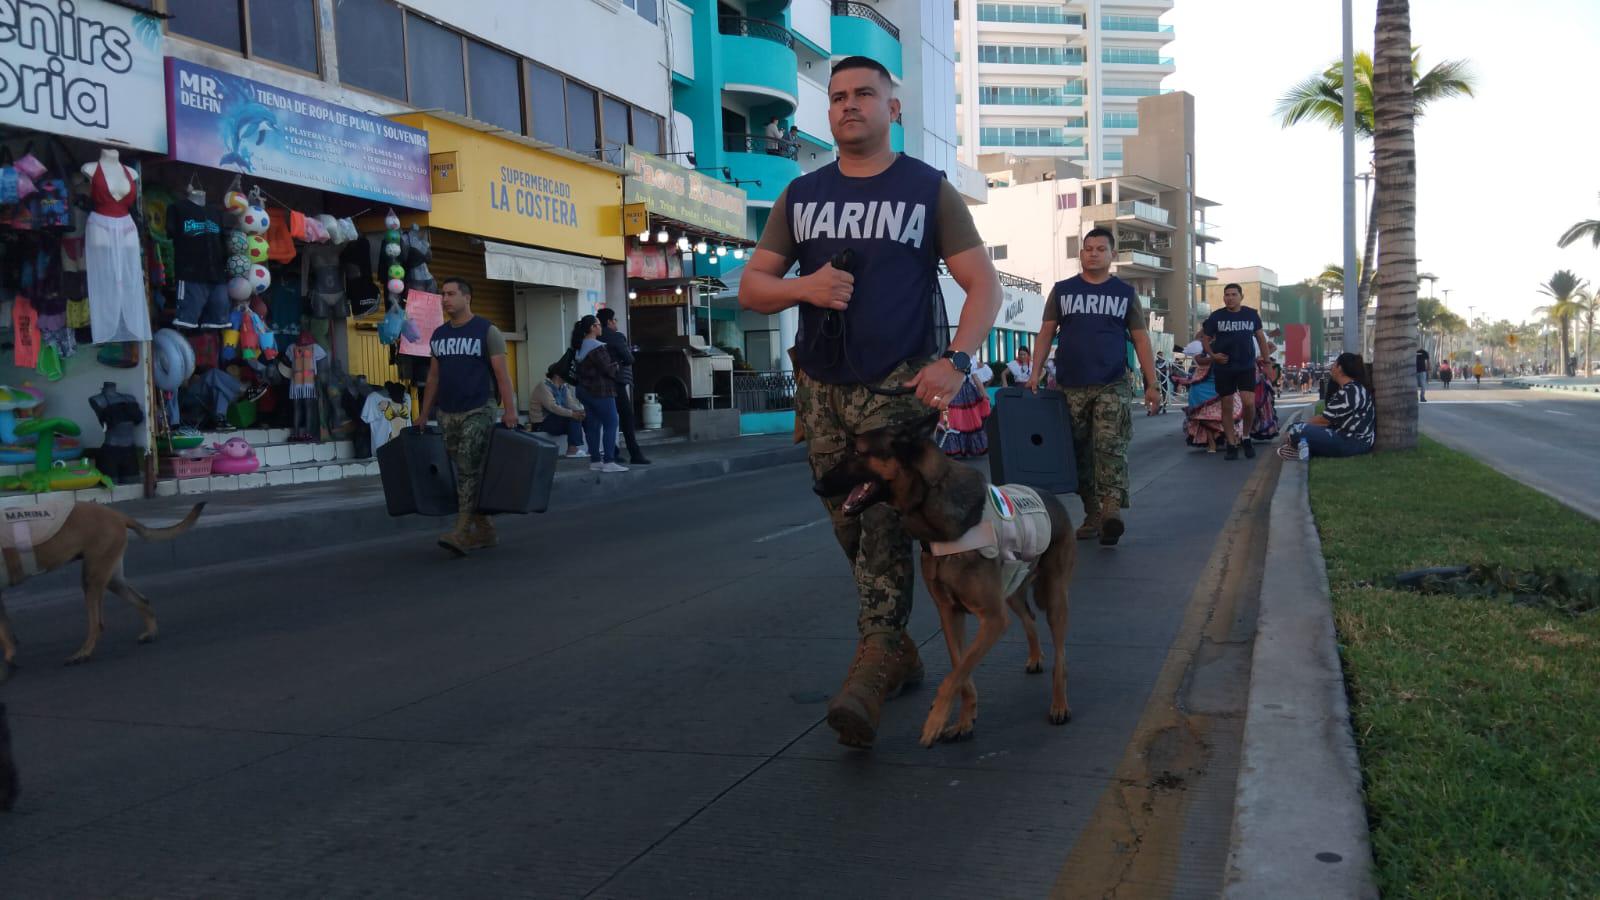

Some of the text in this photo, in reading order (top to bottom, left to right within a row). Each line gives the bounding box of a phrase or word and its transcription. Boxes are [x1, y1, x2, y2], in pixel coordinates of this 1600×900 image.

[180, 70, 223, 99] MR.
[181, 91, 221, 114] DELFIN
[257, 89, 427, 147] TIENDA DE ROPA DE PLAYA Y SOUVENIRS
[501, 166, 571, 199] SUPERMERCADO
[491, 181, 578, 227] LA COSTERA
[793, 201, 926, 248] MARINA
[1060, 293, 1129, 319] MARINA
[1217, 320, 1255, 332] MARINA
[431, 338, 482, 357] MARINA
[5, 510, 51, 520] MARINA
